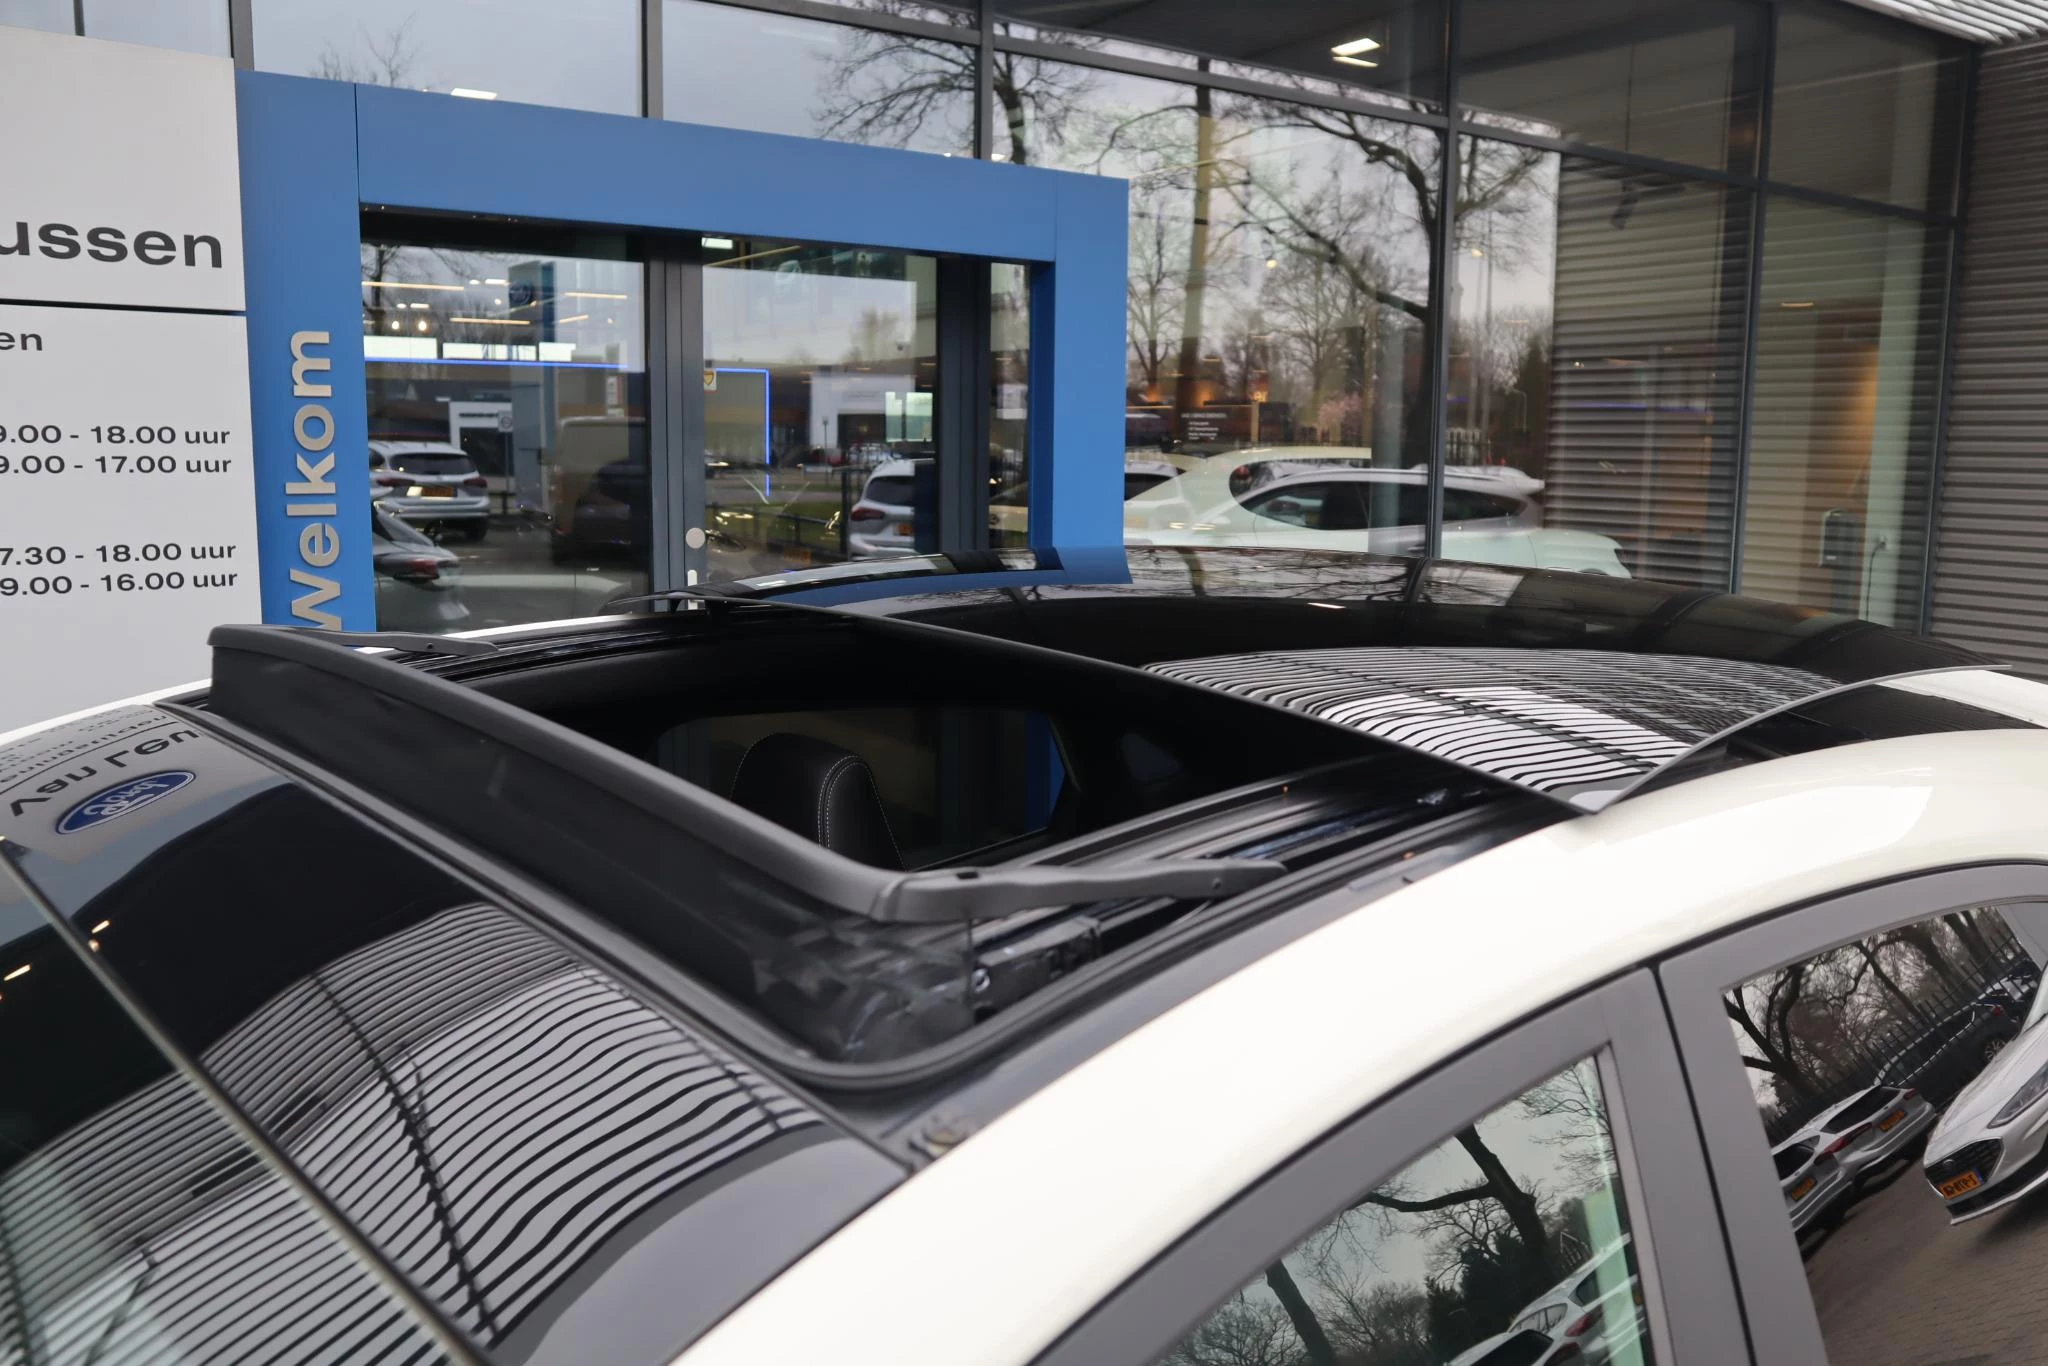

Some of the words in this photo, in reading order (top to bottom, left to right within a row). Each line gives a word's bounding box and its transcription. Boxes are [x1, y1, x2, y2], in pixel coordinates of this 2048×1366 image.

[0, 221, 223, 269] ussen
[0, 331, 43, 352] en
[90, 425, 177, 445] 18.00
[184, 430, 231, 445] uur
[95, 455, 177, 474] 17.00
[185, 459, 232, 473] uur
[285, 330, 342, 632] Welkom
[0, 546, 67, 566] 7.30
[95, 542, 182, 563] 18.00
[190, 544, 237, 560] uur
[0, 575, 73, 597] 9.00
[100, 571, 185, 592] 16.00
[193, 572, 238, 588] uur
